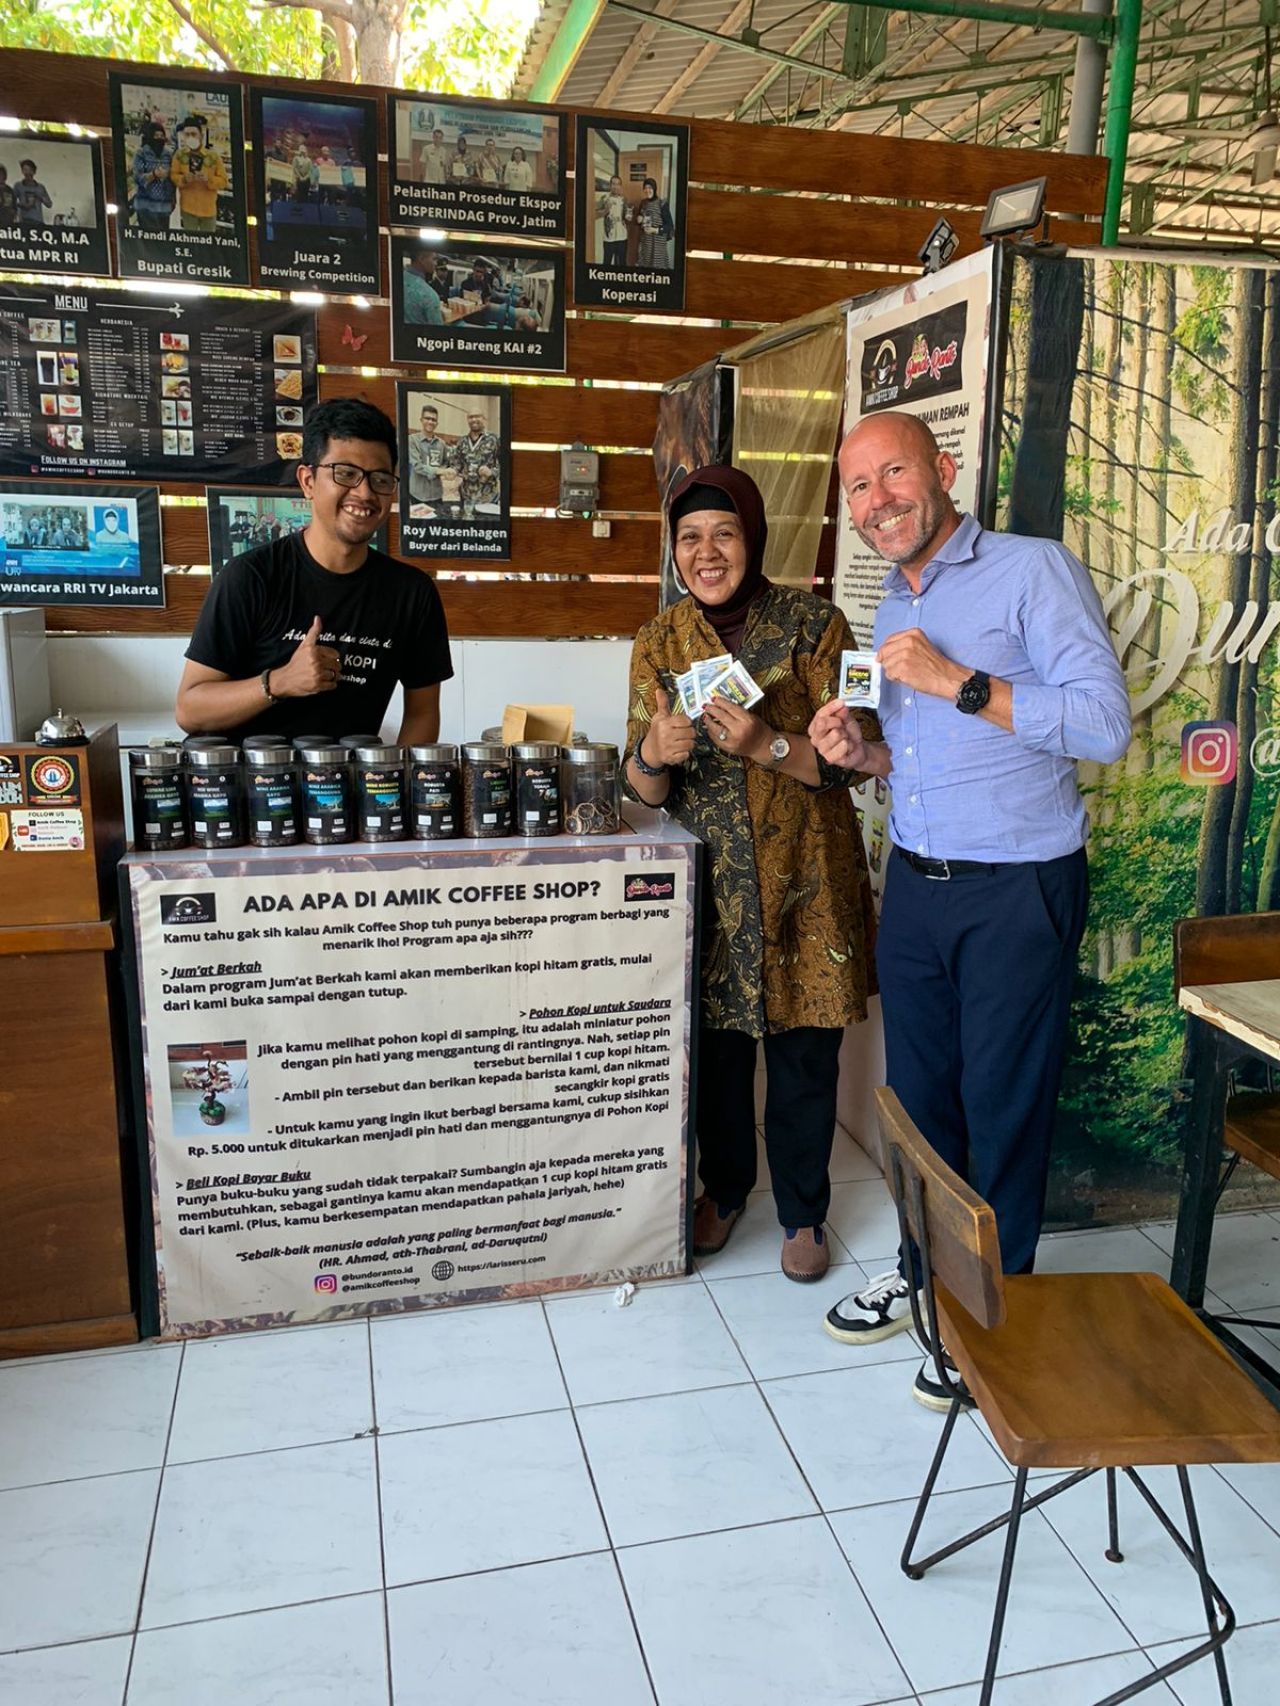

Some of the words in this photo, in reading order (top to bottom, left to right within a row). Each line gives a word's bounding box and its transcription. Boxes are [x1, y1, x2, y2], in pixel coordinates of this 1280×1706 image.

[394, 185, 455, 201] Pelatihan
[459, 191, 516, 206] Prosedur
[519, 196, 561, 211] Ekspor
[399, 204, 484, 222] DISPERINDAG
[488, 211, 520, 225] Prov.
[521, 215, 556, 228] Jatim
[30, 229, 57, 245] S.Q,
[61, 231, 90, 245] M.A
[124, 228, 136, 238] H.
[138, 230, 166, 241] Fandi
[168, 232, 212, 244] Akhmad
[214, 236, 240, 248] Yani,
[28, 249, 61, 262] MPR
[64, 251, 78, 263] RI
[175, 247, 192, 257] S.E.
[293, 250, 330, 264] Juara
[333, 253, 341, 265] 2
[137, 260, 183, 280] Bupati
[186, 264, 231, 280] Gresik
[260, 265, 306, 280] Brewing
[308, 269, 374, 283] Competition
[589, 268, 670, 284] Kementerian
[54, 295, 88, 310] MENU
[602, 288, 656, 303] Koperasi
[417, 337, 454, 352] Ngopi
[457, 339, 500, 355] Bareng
[504, 342, 524, 353] KAI
[527, 344, 542, 354] #2
[939, 402, 970, 422] REMPAH
[41, 455, 67, 465] FOLLOW
[69, 457, 78, 465] US
[79, 458, 88, 466] ON
[89, 458, 126, 467] INSTAGRAM
[403, 525, 426, 538] Roy
[428, 526, 506, 540] Wasenhagen
[1161, 507, 1252, 554] Ada
[409, 541, 438, 552] Buyer
[440, 542, 460, 550] dari
[462, 540, 502, 552] Belanda
[64, 583, 86, 593] RRI
[88, 583, 106, 593] TV
[108, 583, 158, 596] Jakarta
[344, 653, 377, 669] KOPI
[243, 894, 294, 913] ADA
[300, 892, 348, 910] APA
[355, 890, 376, 908] DI
[383, 887, 442, 906] AMIK
[448, 884, 526, 903] COFFEE
[532, 880, 600, 899] SHOP?
[163, 933, 200, 943] Kamu
[203, 930, 234, 941] tahu
[237, 928, 260, 942] gak
[262, 927, 281, 938] sih
[284, 926, 319, 937] kalau
[322, 923, 354, 934] Amik
[357, 921, 396, 933] Coffee
[399, 920, 428, 932] Shop
[431, 918, 452, 929] tuh
[455, 918, 491, 930] punya
[494, 915, 547, 926] beberapa
[550, 912, 598, 925] program
[600, 908, 641, 920] berbagi
[643, 908, 669, 920] yang
[322, 937, 374, 950] menarik
[377, 937, 399, 947] lho!
[402, 936, 453, 947] Program
[456, 934, 477, 945] apa
[480, 931, 498, 944] aja
[500, 929, 533, 940] sih???
[162, 983, 206, 994] Dalam
[209, 980, 266, 995] program
[316, 971, 361, 985] Berkah
[365, 969, 396, 981] kami
[400, 968, 430, 979] akan
[434, 963, 512, 977] memberikan
[514, 960, 540, 973] kopi
[543, 960, 578, 970] hitam
[580, 956, 617, 970] gratis,
[620, 953, 652, 965] mulai
[217, 960, 261, 974] Berkah
[163, 999, 190, 1011] dari
[193, 997, 227, 1010] kami
[230, 995, 264, 1007] buka
[267, 991, 314, 1005] sampai
[317, 990, 365, 1002] dengan
[368, 987, 407, 998] tutup.
[529, 1007, 564, 1017] Pohon
[566, 1003, 591, 1015] Kopi
[593, 1001, 625, 1013] untuk
[627, 998, 671, 1011] Saudara
[257, 1043, 282, 1057] Jika
[286, 1042, 322, 1053] kamu
[326, 1036, 375, 1049] melihat
[378, 1034, 417, 1047] pohon
[421, 1030, 447, 1044] kopi
[450, 1029, 462, 1040] di
[464, 1026, 519, 1039] samping,
[522, 1024, 538, 1034] itu
[541, 1020, 580, 1032] adalah
[584, 1017, 634, 1029] miniatur
[636, 1013, 670, 1027] pohon
[186, 1176, 210, 1189] Beli
[213, 1175, 240, 1187] Kopi
[243, 1173, 278, 1185] Bayar
[280, 1170, 311, 1182] Buku
[312, 1239, 363, 1253] manusia
[365, 1234, 405, 1248] adalah
[406, 1232, 436, 1245] yang
[436, 1227, 473, 1242] paling
[474, 1219, 540, 1235] bermanfaat
[542, 1214, 566, 1227] bagi
[319, 1257, 342, 1269] (HR.
[345, 1250, 389, 1265] Ahmad,
[392, 1241, 468, 1259] ath-Thabrani,
[471, 1232, 547, 1250] ad-Daruqutni)
[457, 1256, 546, 1272] https://larisseru.com
[341, 1266, 413, 1282] @bundoranto.id
[342, 1277, 420, 1292] @amikcoffeeshop
